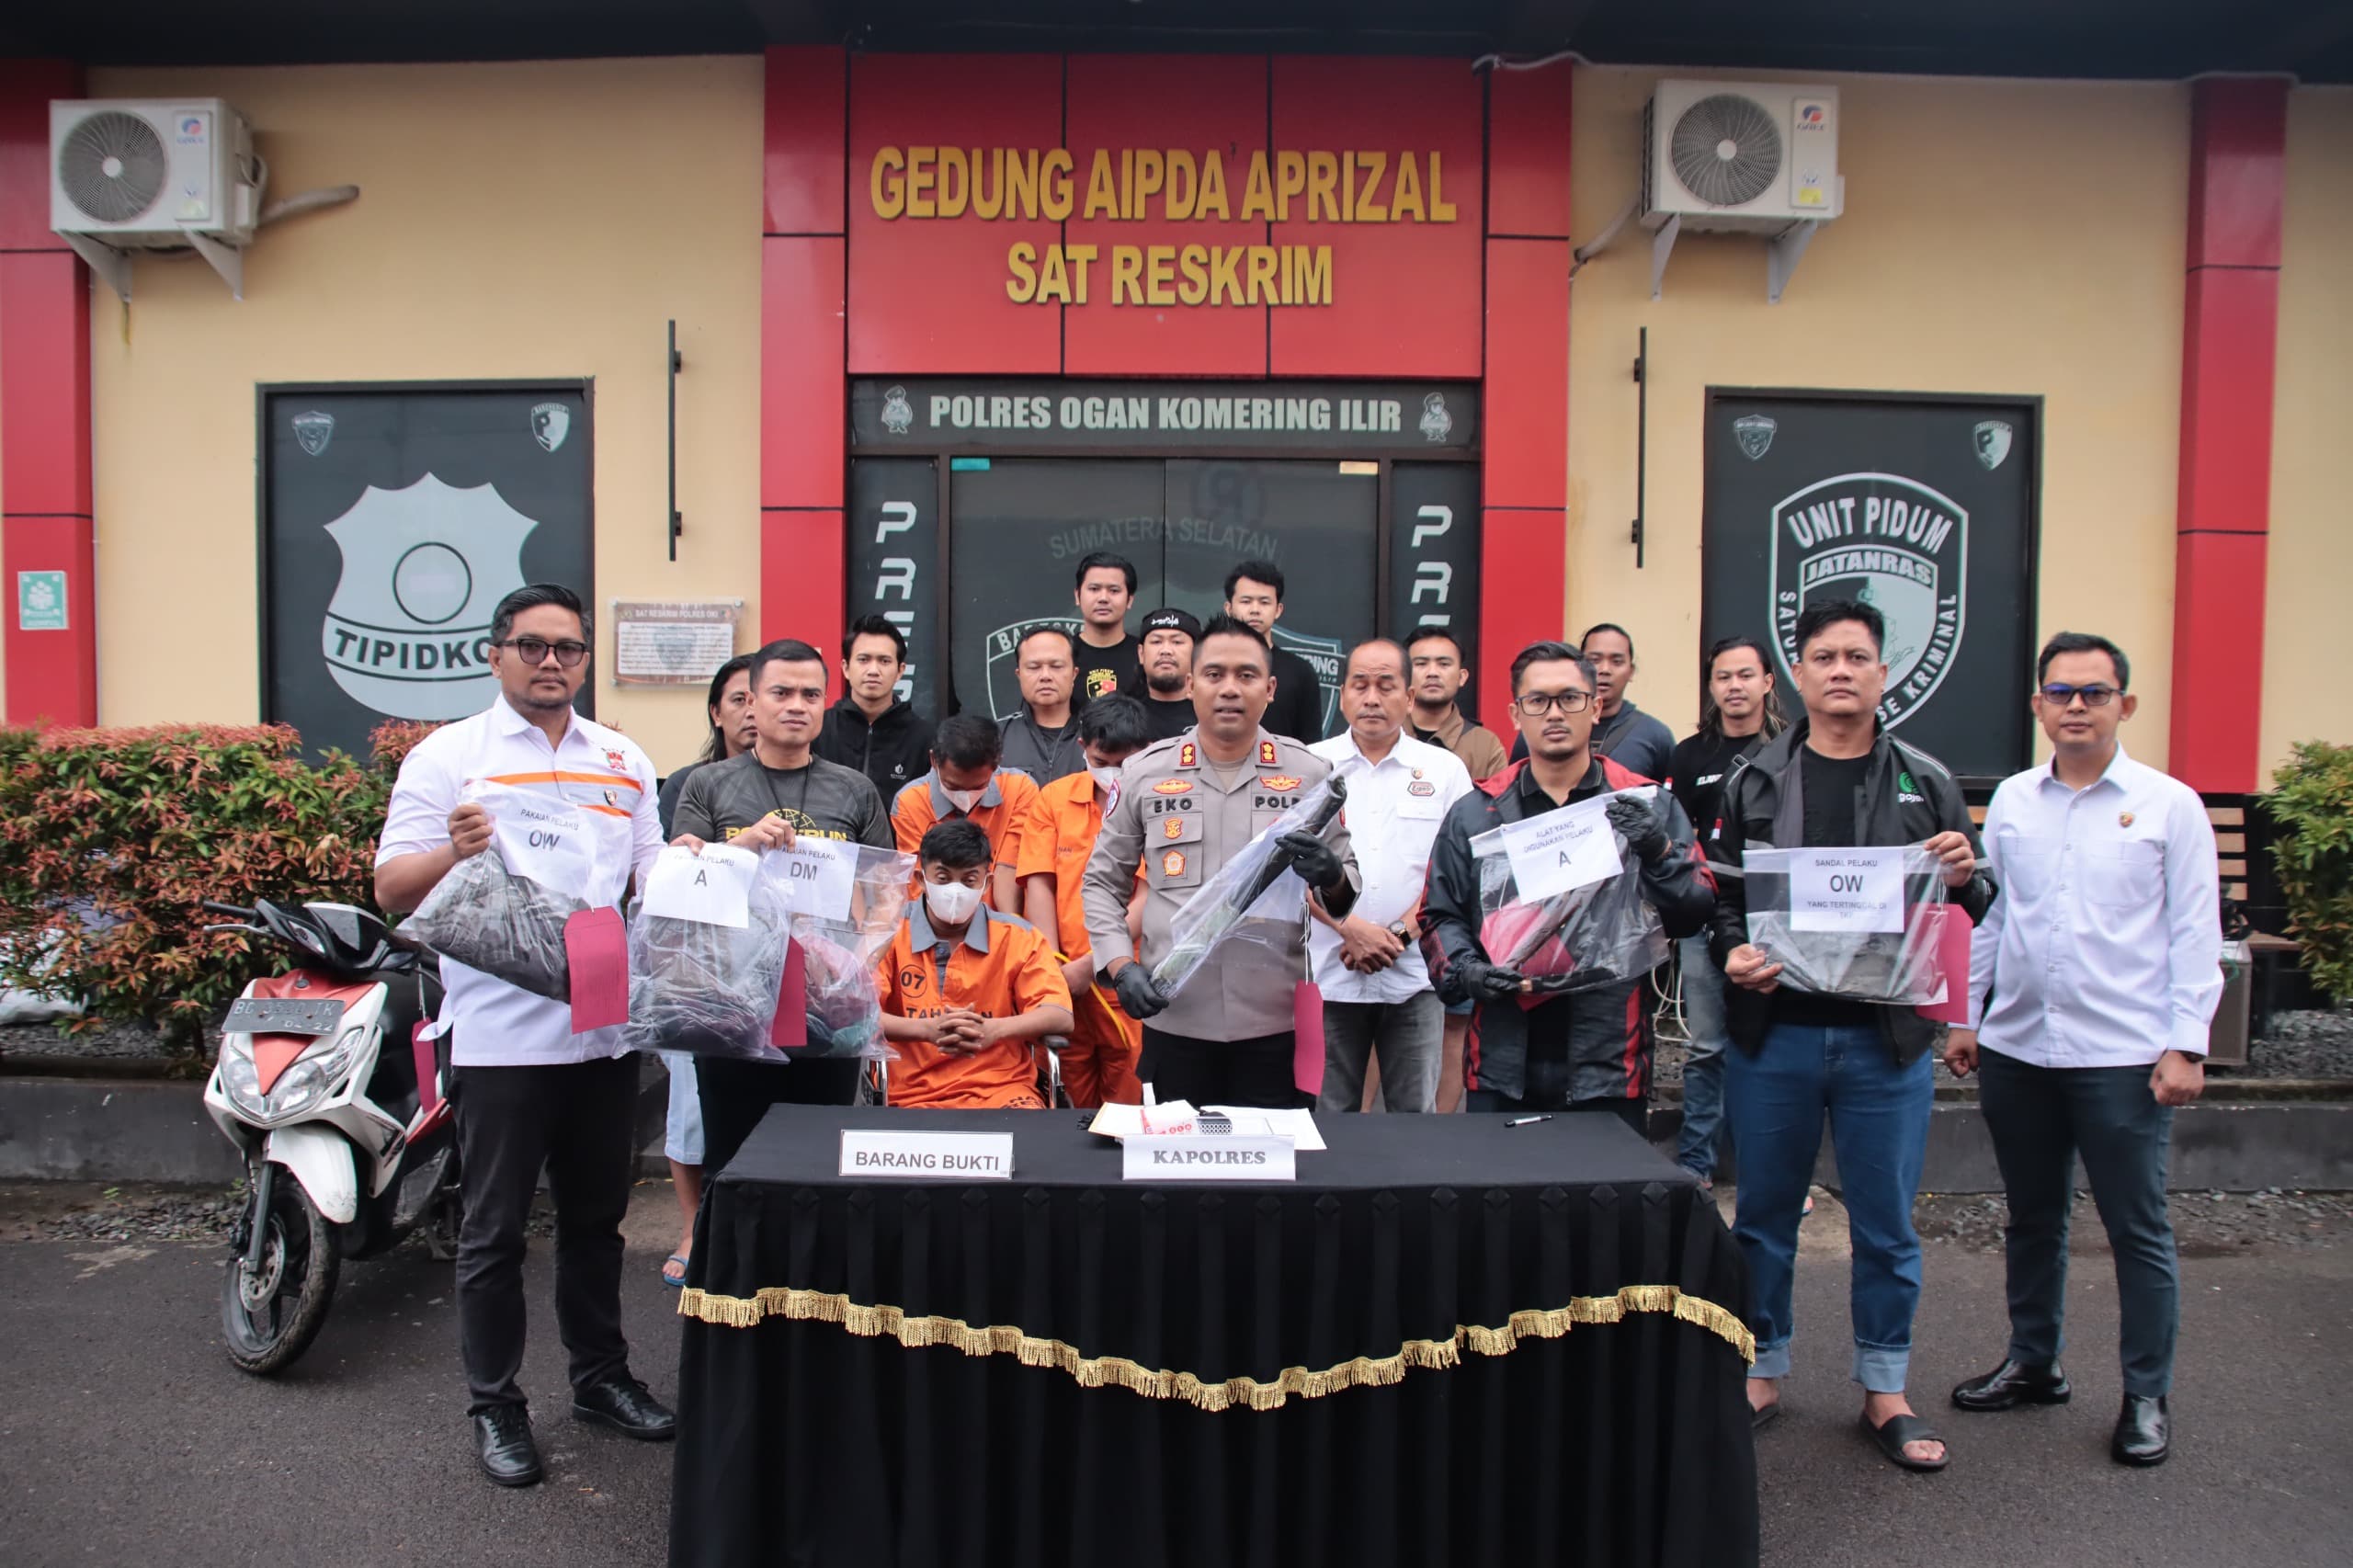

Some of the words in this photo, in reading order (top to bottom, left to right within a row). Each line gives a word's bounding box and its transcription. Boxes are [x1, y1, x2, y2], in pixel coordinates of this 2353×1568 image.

[870, 146, 1074, 222] GEDUNG
[1083, 148, 1231, 221] AIPDA
[1241, 150, 1457, 222] APRIZAL
[1006, 242, 1098, 304] SAT
[1112, 244, 1333, 306] RESKRIM
[930, 395, 1051, 428] POLRES
[1060, 397, 1150, 429] OGAN
[1158, 397, 1332, 430] KOMERING
[1339, 399, 1402, 431] ILIR
[1787, 496, 1857, 550] UNIT
[1865, 496, 1953, 554] PIDUM
[1050, 517, 1174, 559] SUMATERA
[1179, 517, 1279, 560] SELATAN
[1805, 551, 1932, 585] JATANRAS
[1903, 594, 1957, 700] KRIMINAL
[1154, 797, 1193, 813] EKO
[520, 809, 550, 824] PAKAIAN
[1554, 821, 1574, 832] YANG
[529, 829, 561, 852] OW
[808, 850, 835, 861] PELAKU
[1559, 850, 1572, 868] A
[694, 869, 708, 887] A
[790, 861, 818, 881] DM
[1829, 874, 1863, 892] OW
[901, 971, 926, 990] 07
[856, 1151, 937, 1168] BARANG
[942, 1154, 999, 1171] BUKTI
[1153, 1150, 1267, 1165] KAPOLRES
